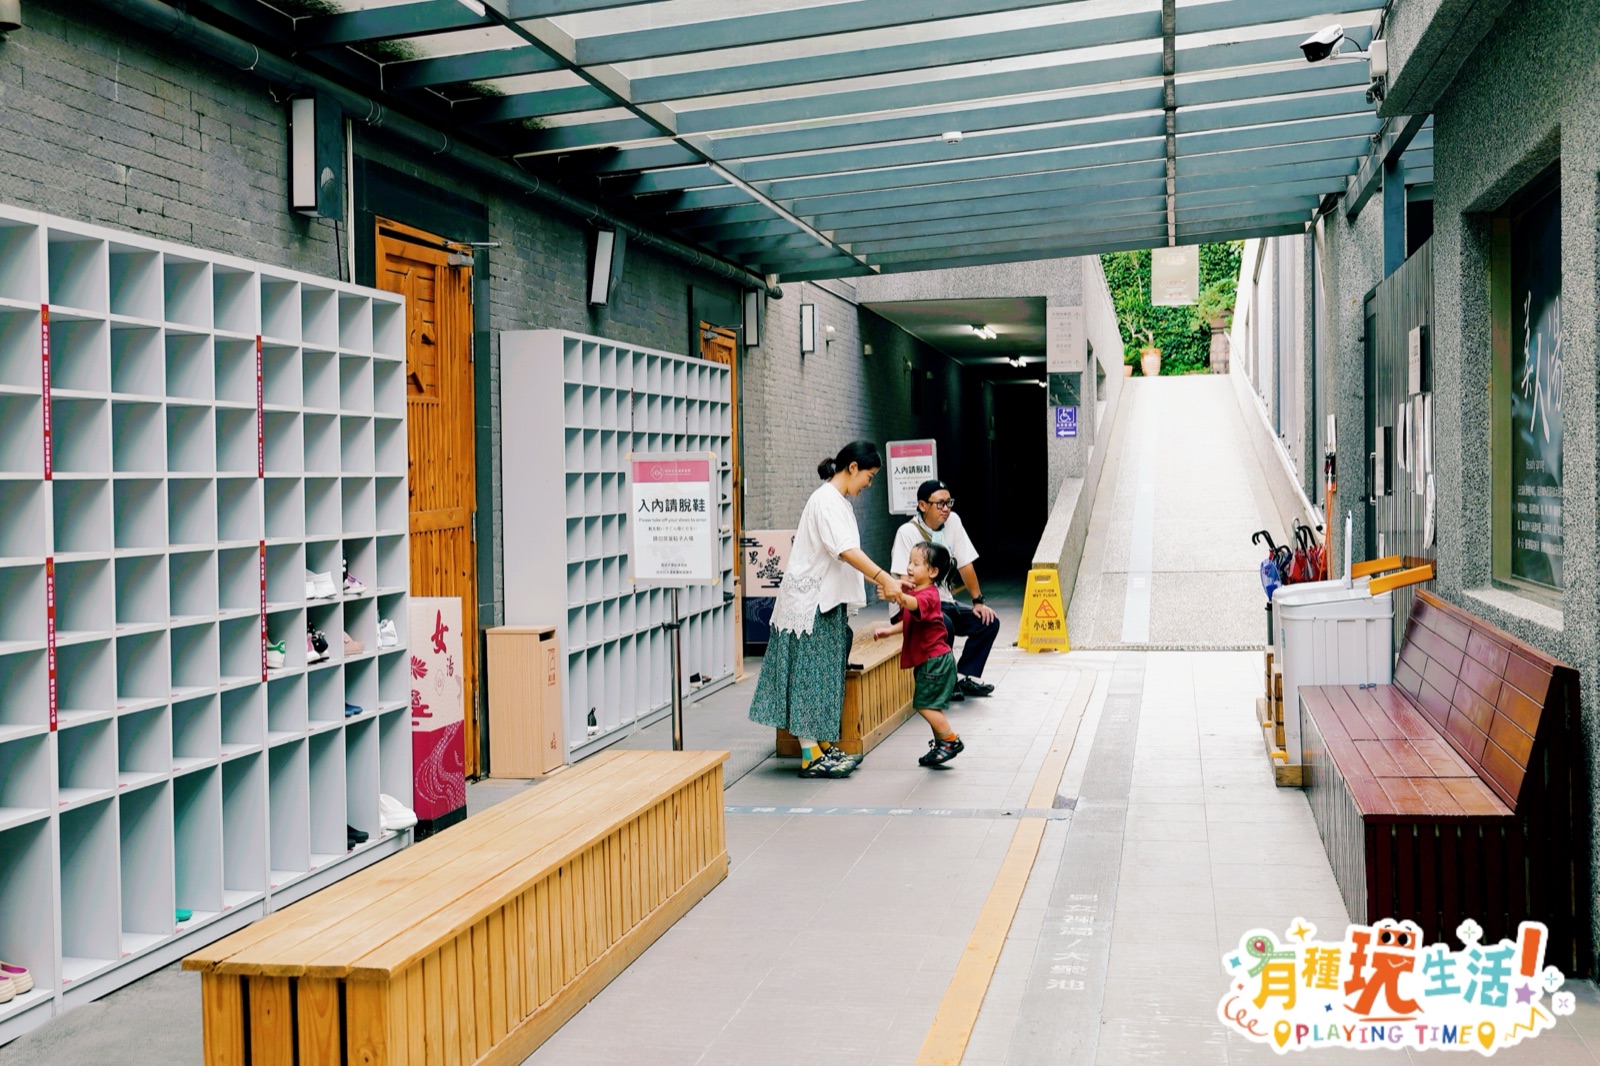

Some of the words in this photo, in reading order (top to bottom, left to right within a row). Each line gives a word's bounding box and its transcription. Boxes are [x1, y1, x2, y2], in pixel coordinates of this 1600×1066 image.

[638, 498, 706, 513] 入內請脫鞋
[1034, 620, 1061, 631] 小心地滑
